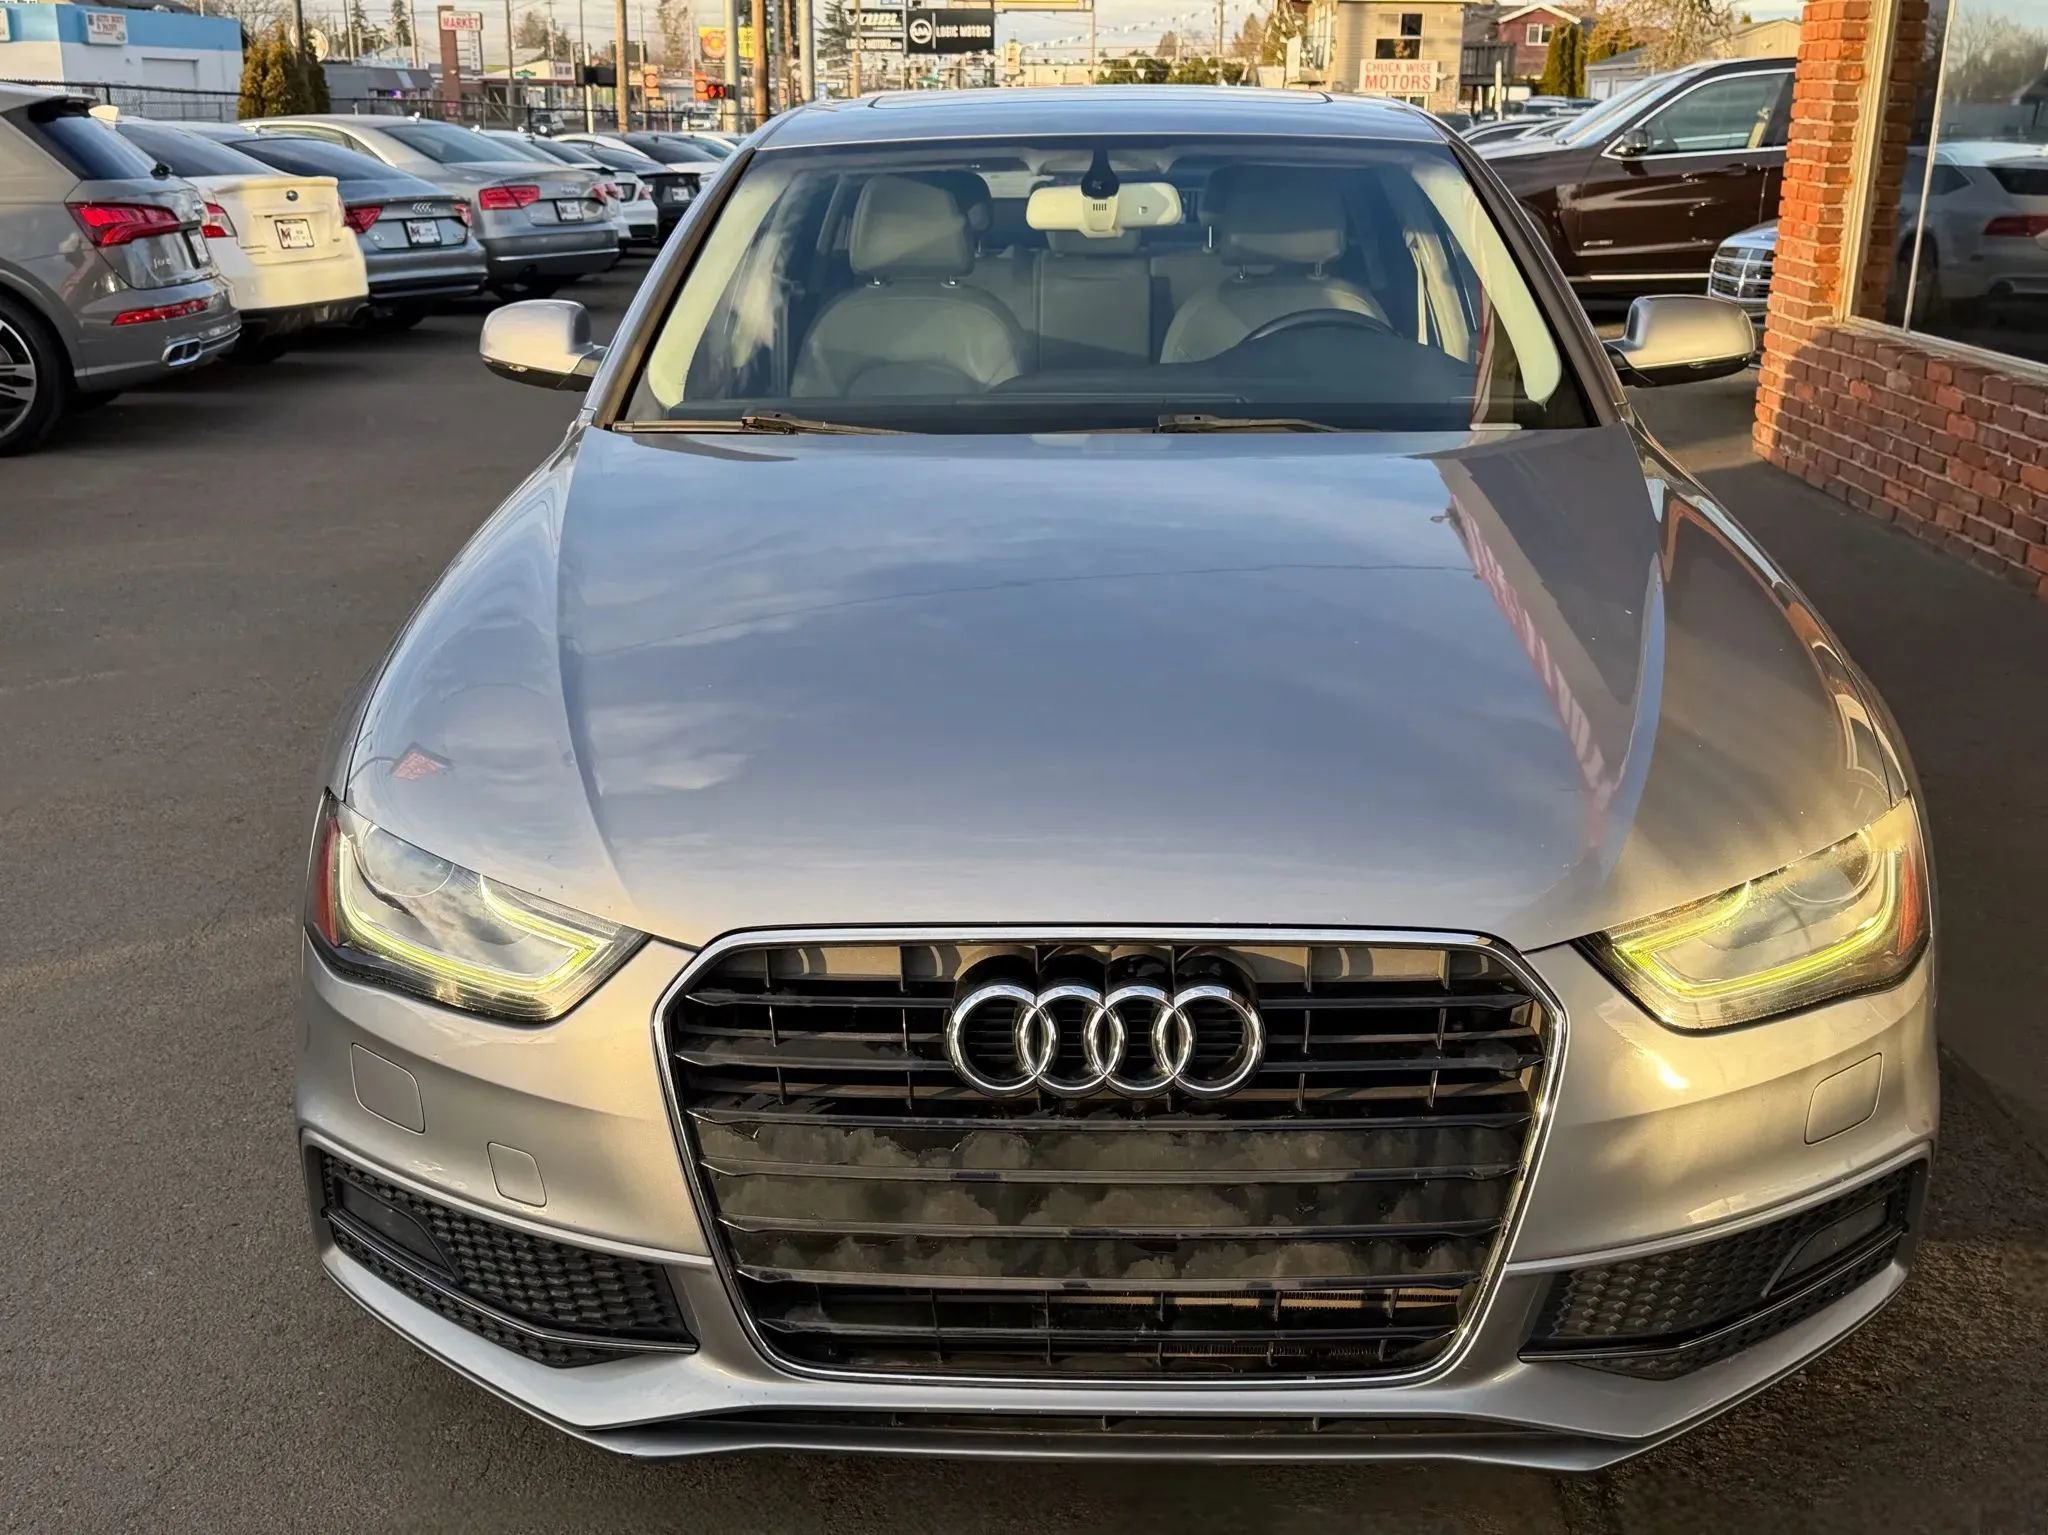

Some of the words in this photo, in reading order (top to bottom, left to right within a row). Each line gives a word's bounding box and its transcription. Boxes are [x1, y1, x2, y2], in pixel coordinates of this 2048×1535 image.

[443, 16, 478, 28] MARKET
[960, 25, 991, 37] MOTORS
[1366, 63, 1400, 73] CHUCK
[1407, 63, 1431, 73] WISE
[1365, 74, 1431, 90] MOTORS
